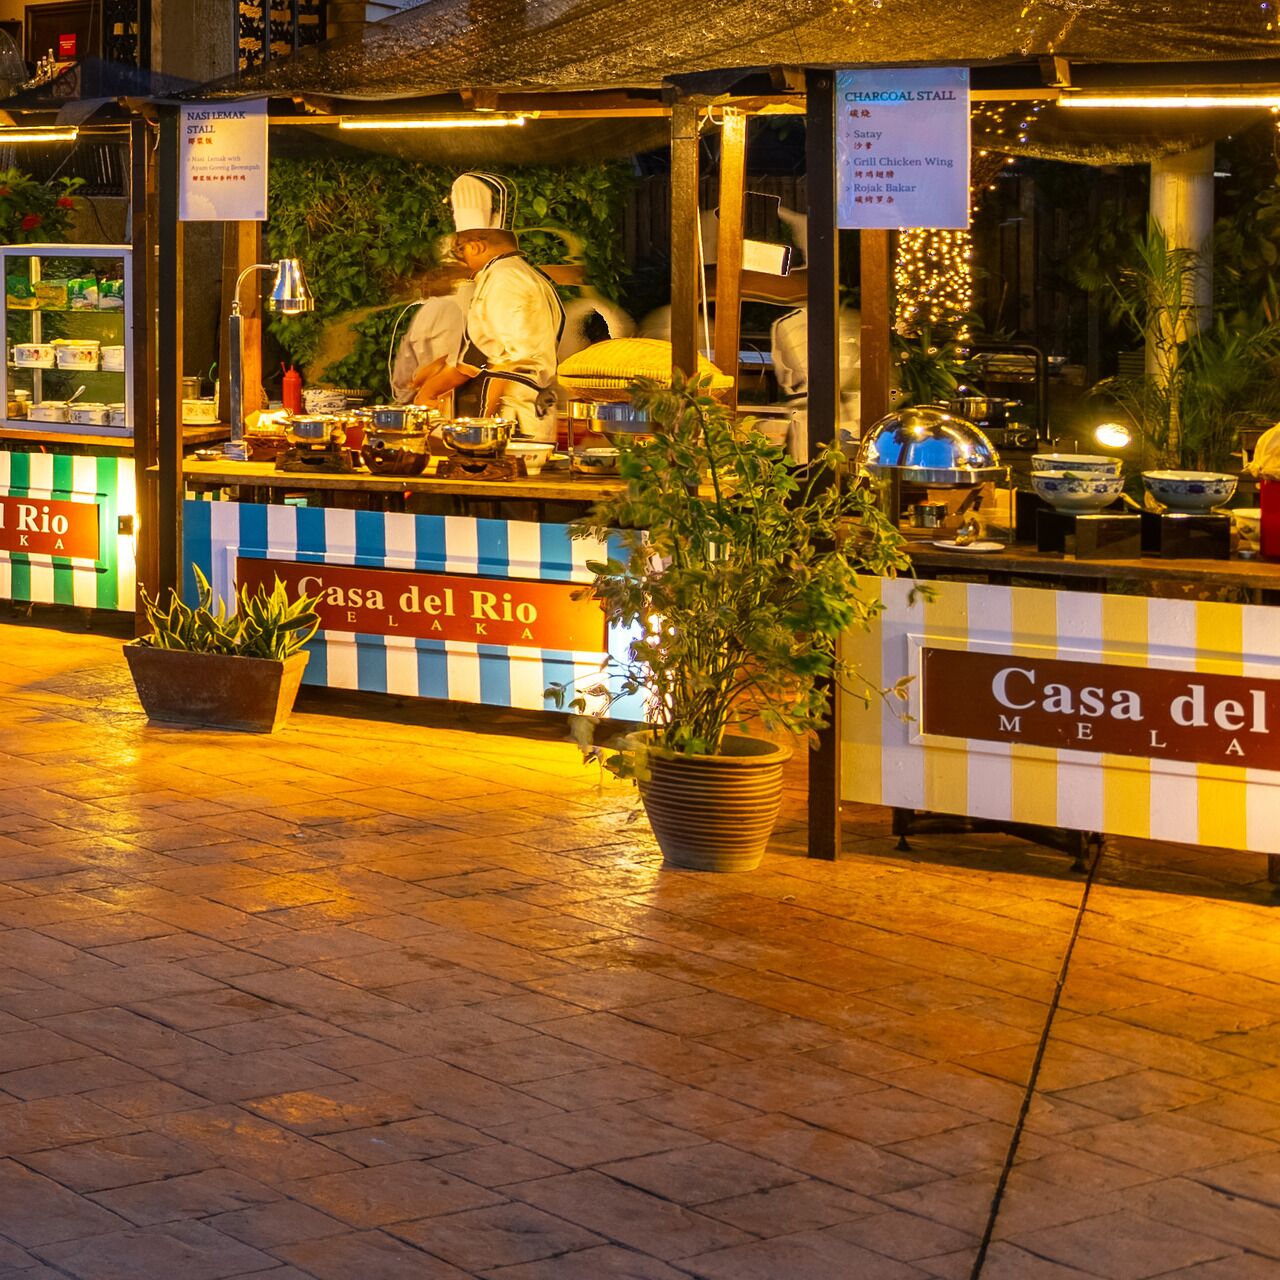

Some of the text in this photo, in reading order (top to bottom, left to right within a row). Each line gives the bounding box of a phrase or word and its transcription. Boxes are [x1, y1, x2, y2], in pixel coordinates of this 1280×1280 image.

[845, 90, 956, 101] CHARCOAL STALL
[187, 111, 246, 120] NASI LEMAK
[187, 125, 215, 134] STALL
[854, 130, 882, 140] Satay
[854, 157, 954, 168] Grill Chicken Wing
[854, 183, 917, 194] Rojak Bakar
[16, 504, 69, 535] Rio
[297, 576, 538, 625] Casa del Rio
[347, 611, 534, 640] ELAKA
[991, 667, 1270, 734] Casa del
